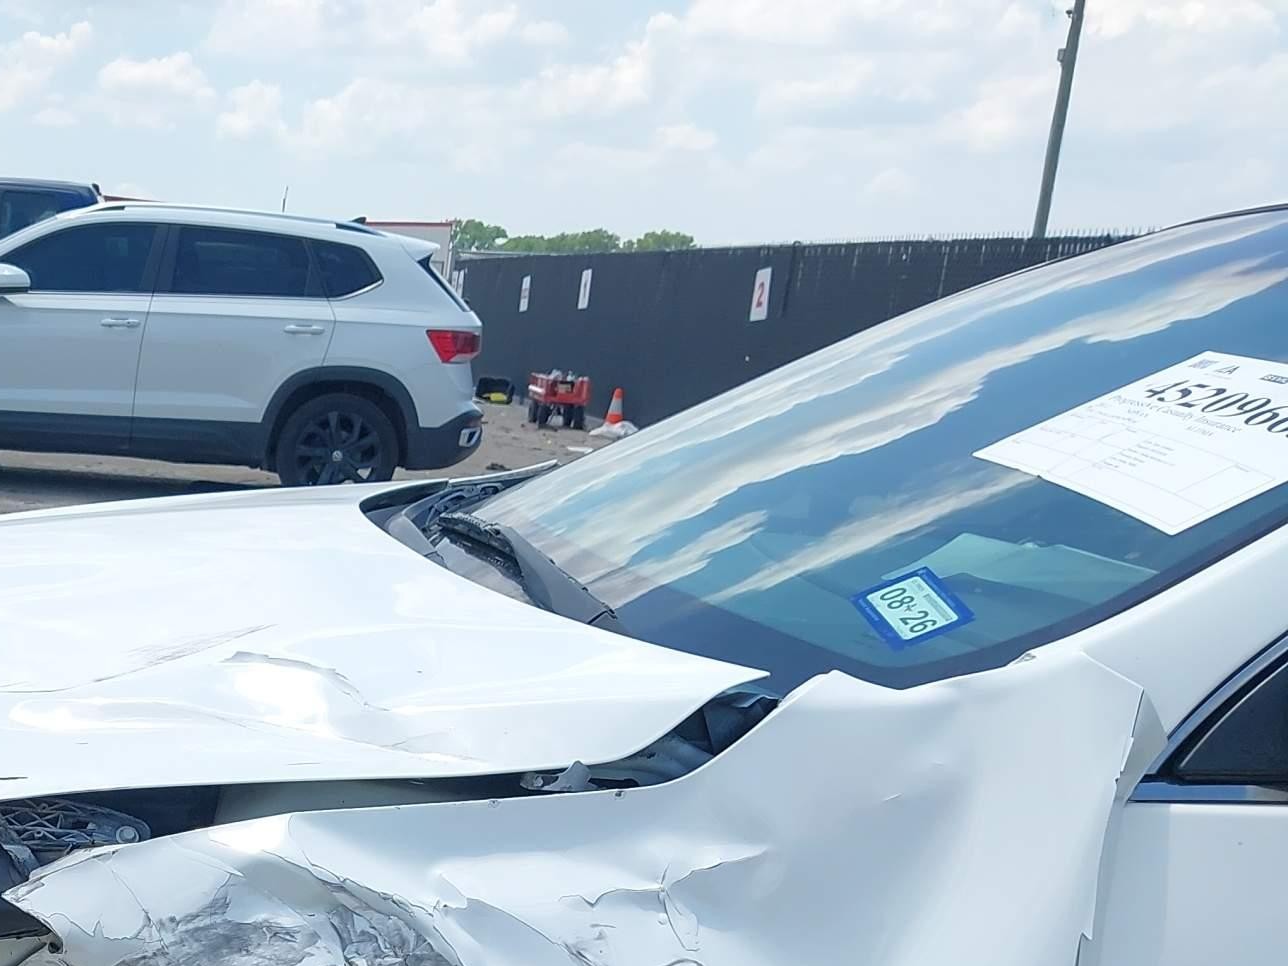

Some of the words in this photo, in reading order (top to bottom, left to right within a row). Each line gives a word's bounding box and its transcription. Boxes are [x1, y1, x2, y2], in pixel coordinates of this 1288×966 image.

[755, 281, 765, 309] 2
[1144, 379, 1288, 438] 452096
[879, 587, 915, 610] 08
[899, 610, 938, 633] 26
